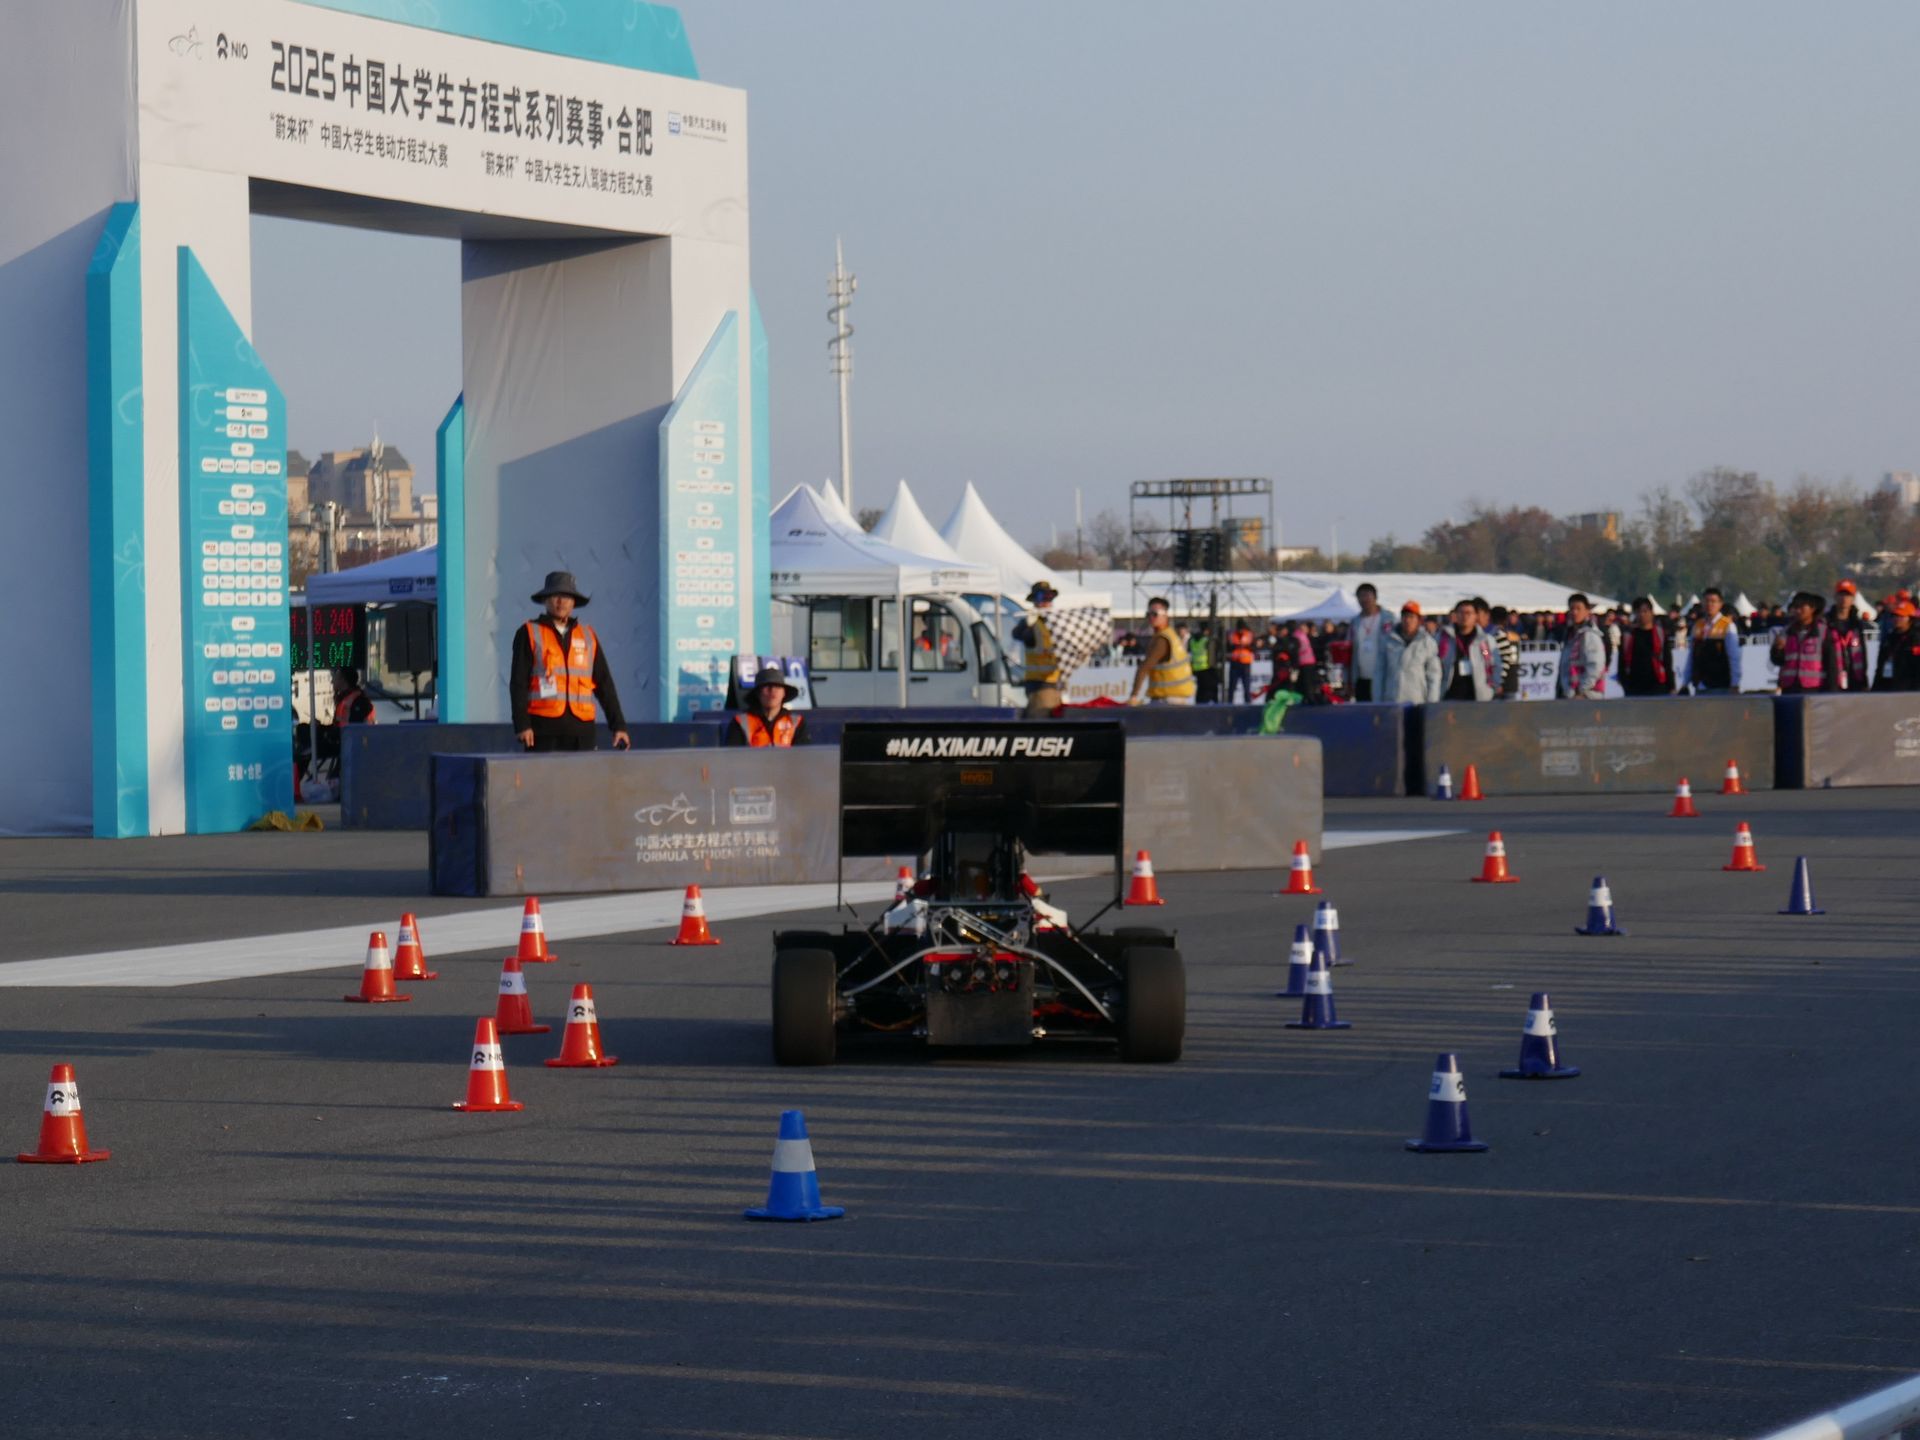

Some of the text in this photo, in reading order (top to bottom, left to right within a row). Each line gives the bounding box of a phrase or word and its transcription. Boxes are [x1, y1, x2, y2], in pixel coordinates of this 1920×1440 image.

[231, 42, 248, 60] NIO
[320, 122, 449, 168] 中国大学生电动方程式大赛
[525, 158, 653, 197] 中国大学生无人驾驶方程式大赛
[886, 737, 1074, 757] #MAXIMUM PUSH
[637, 850, 689, 863] FORMULA
